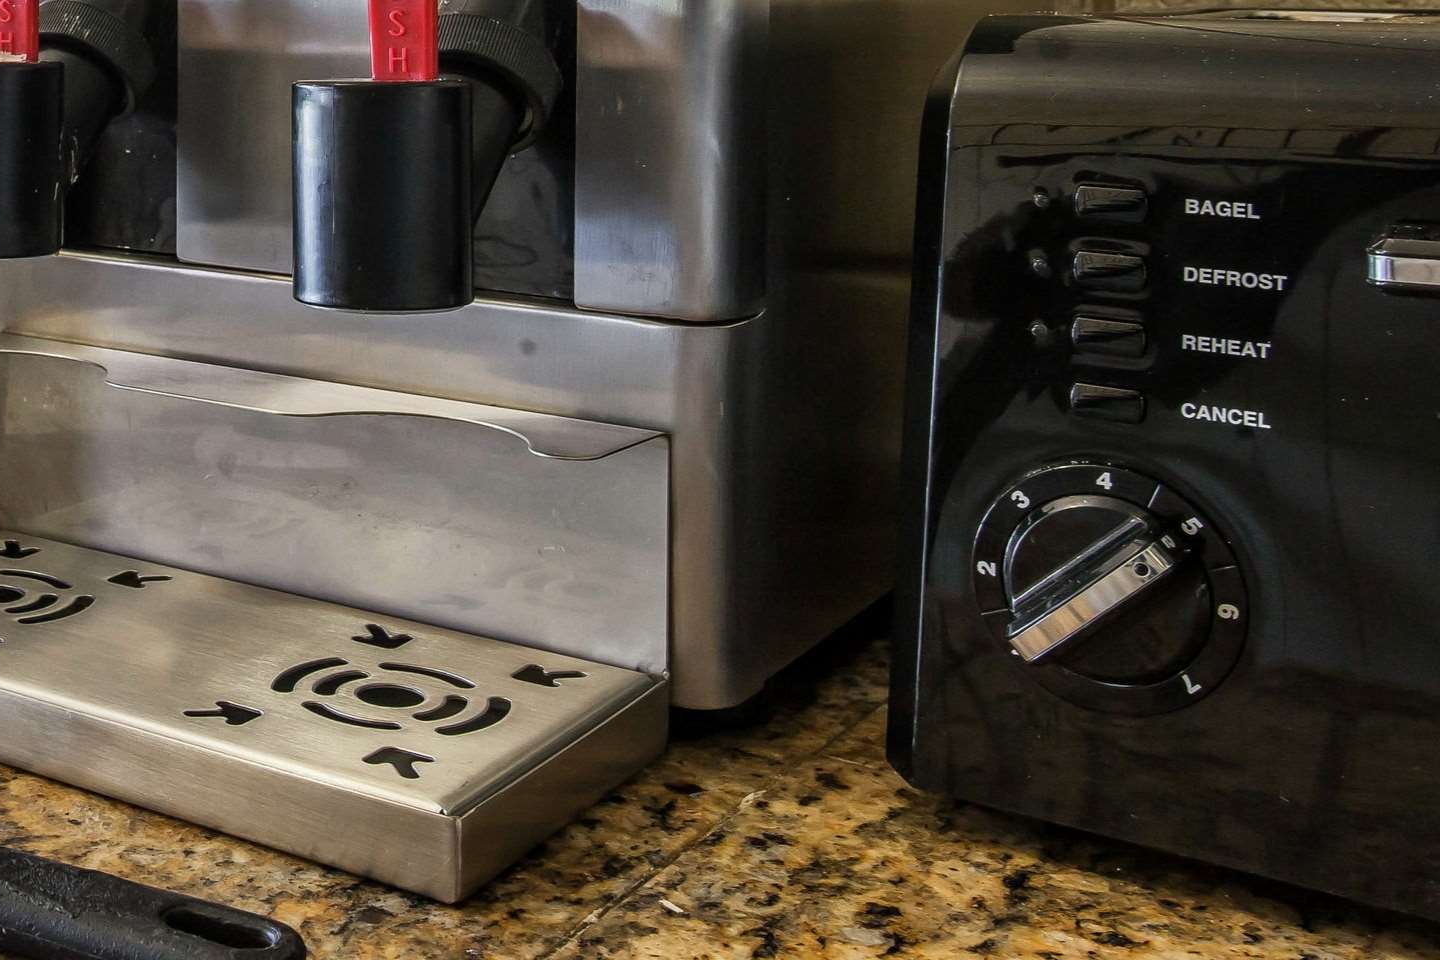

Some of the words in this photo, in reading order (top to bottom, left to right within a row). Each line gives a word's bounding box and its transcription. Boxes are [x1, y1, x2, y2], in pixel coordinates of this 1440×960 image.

[1184, 198, 1261, 221] BAGEL
[1182, 266, 1288, 291] DEFROST
[1180, 334, 1272, 360] REHEAT
[1180, 401, 1272, 429] CANCEL
[1095, 471, 1113, 490] 4
[1010, 490, 1031, 510] 3
[1181, 516, 1204, 536] 5
[977, 560, 997, 577] 2
[1216, 603, 1240, 621] 6
[1181, 672, 1202, 695] 7
